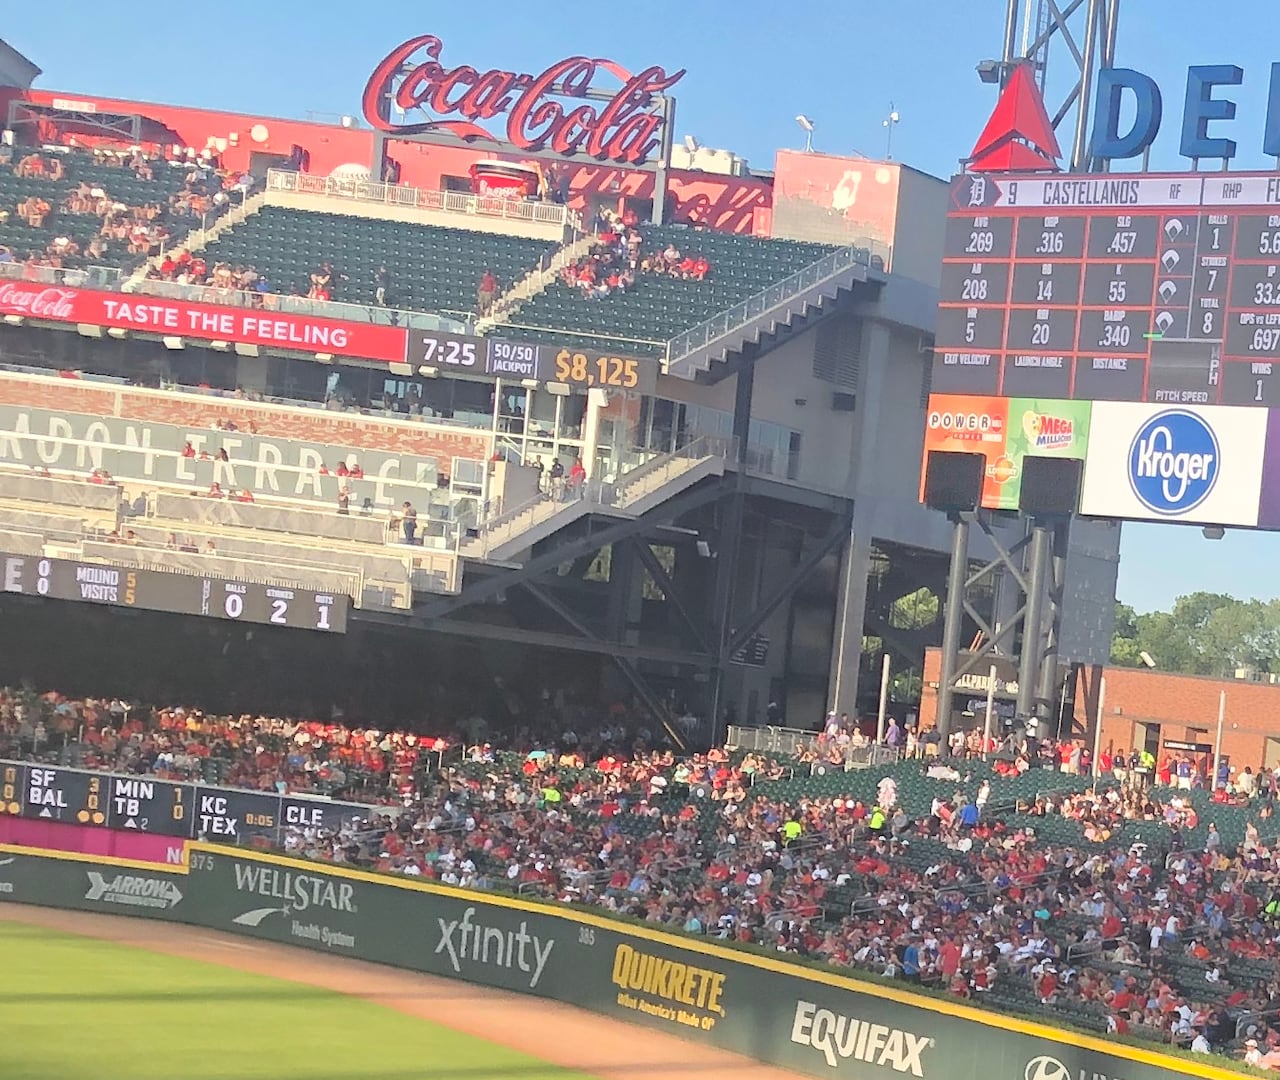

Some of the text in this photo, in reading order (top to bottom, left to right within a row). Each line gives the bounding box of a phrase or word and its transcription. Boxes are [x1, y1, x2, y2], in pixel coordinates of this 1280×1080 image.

[362, 34, 687, 164] Coca-Cola
[1008, 182, 1018, 204] 9
[1043, 180, 1139, 205] CASTELLANOS
[1170, 184, 1182, 200] RF
[1222, 183, 1242, 199] RHP
[965, 231, 994, 253] .269
[1035, 231, 1064, 253] .316
[1107, 231, 1137, 253] .457
[962, 279, 988, 300] 208
[1036, 280, 1052, 301] 14
[1109, 281, 1126, 302] 55
[1207, 270, 1217, 292] 7
[103, 300, 348, 348] TASTE THE FEELING
[965, 322, 975, 343] 5
[1203, 312, 1213, 334] 8
[1032, 324, 1049, 345] 20
[1099, 325, 1130, 347] .340
[1248, 329, 1280, 351] .697
[422, 338, 476, 366] 7:25
[494, 343, 533, 361] 50/50
[492, 359, 533, 375] JACKPOT
[555, 350, 638, 388] $8,125
[1155, 390, 1208, 403] PITCH SPEED
[1254, 379, 1263, 401] 1
[1039, 415, 1072, 435] MEGA
[1137, 426, 1213, 503] Kroger
[76, 566, 136, 588] MOUND 5
[80, 583, 136, 605] VISITS 5
[224, 594, 243, 618] 0
[270, 599, 288, 624] 2
[316, 605, 330, 629] 1
[30, 768, 56, 786] SF
[29, 788, 68, 809] BAL
[115, 778, 154, 800] MIN
[115, 797, 139, 817] TB
[201, 795, 227, 816] KC
[286, 805, 323, 828] CLE
[200, 814, 237, 836] TEX
[190, 854, 214, 871] 375
[110, 874, 171, 899] ARROW
[234, 863, 355, 913] WELLSTAR
[291, 919, 355, 948] Health System
[434, 906, 554, 988] xfinity
[612, 943, 727, 1013] QUIKRETE
[790, 999, 925, 1078] EQUIFAX
